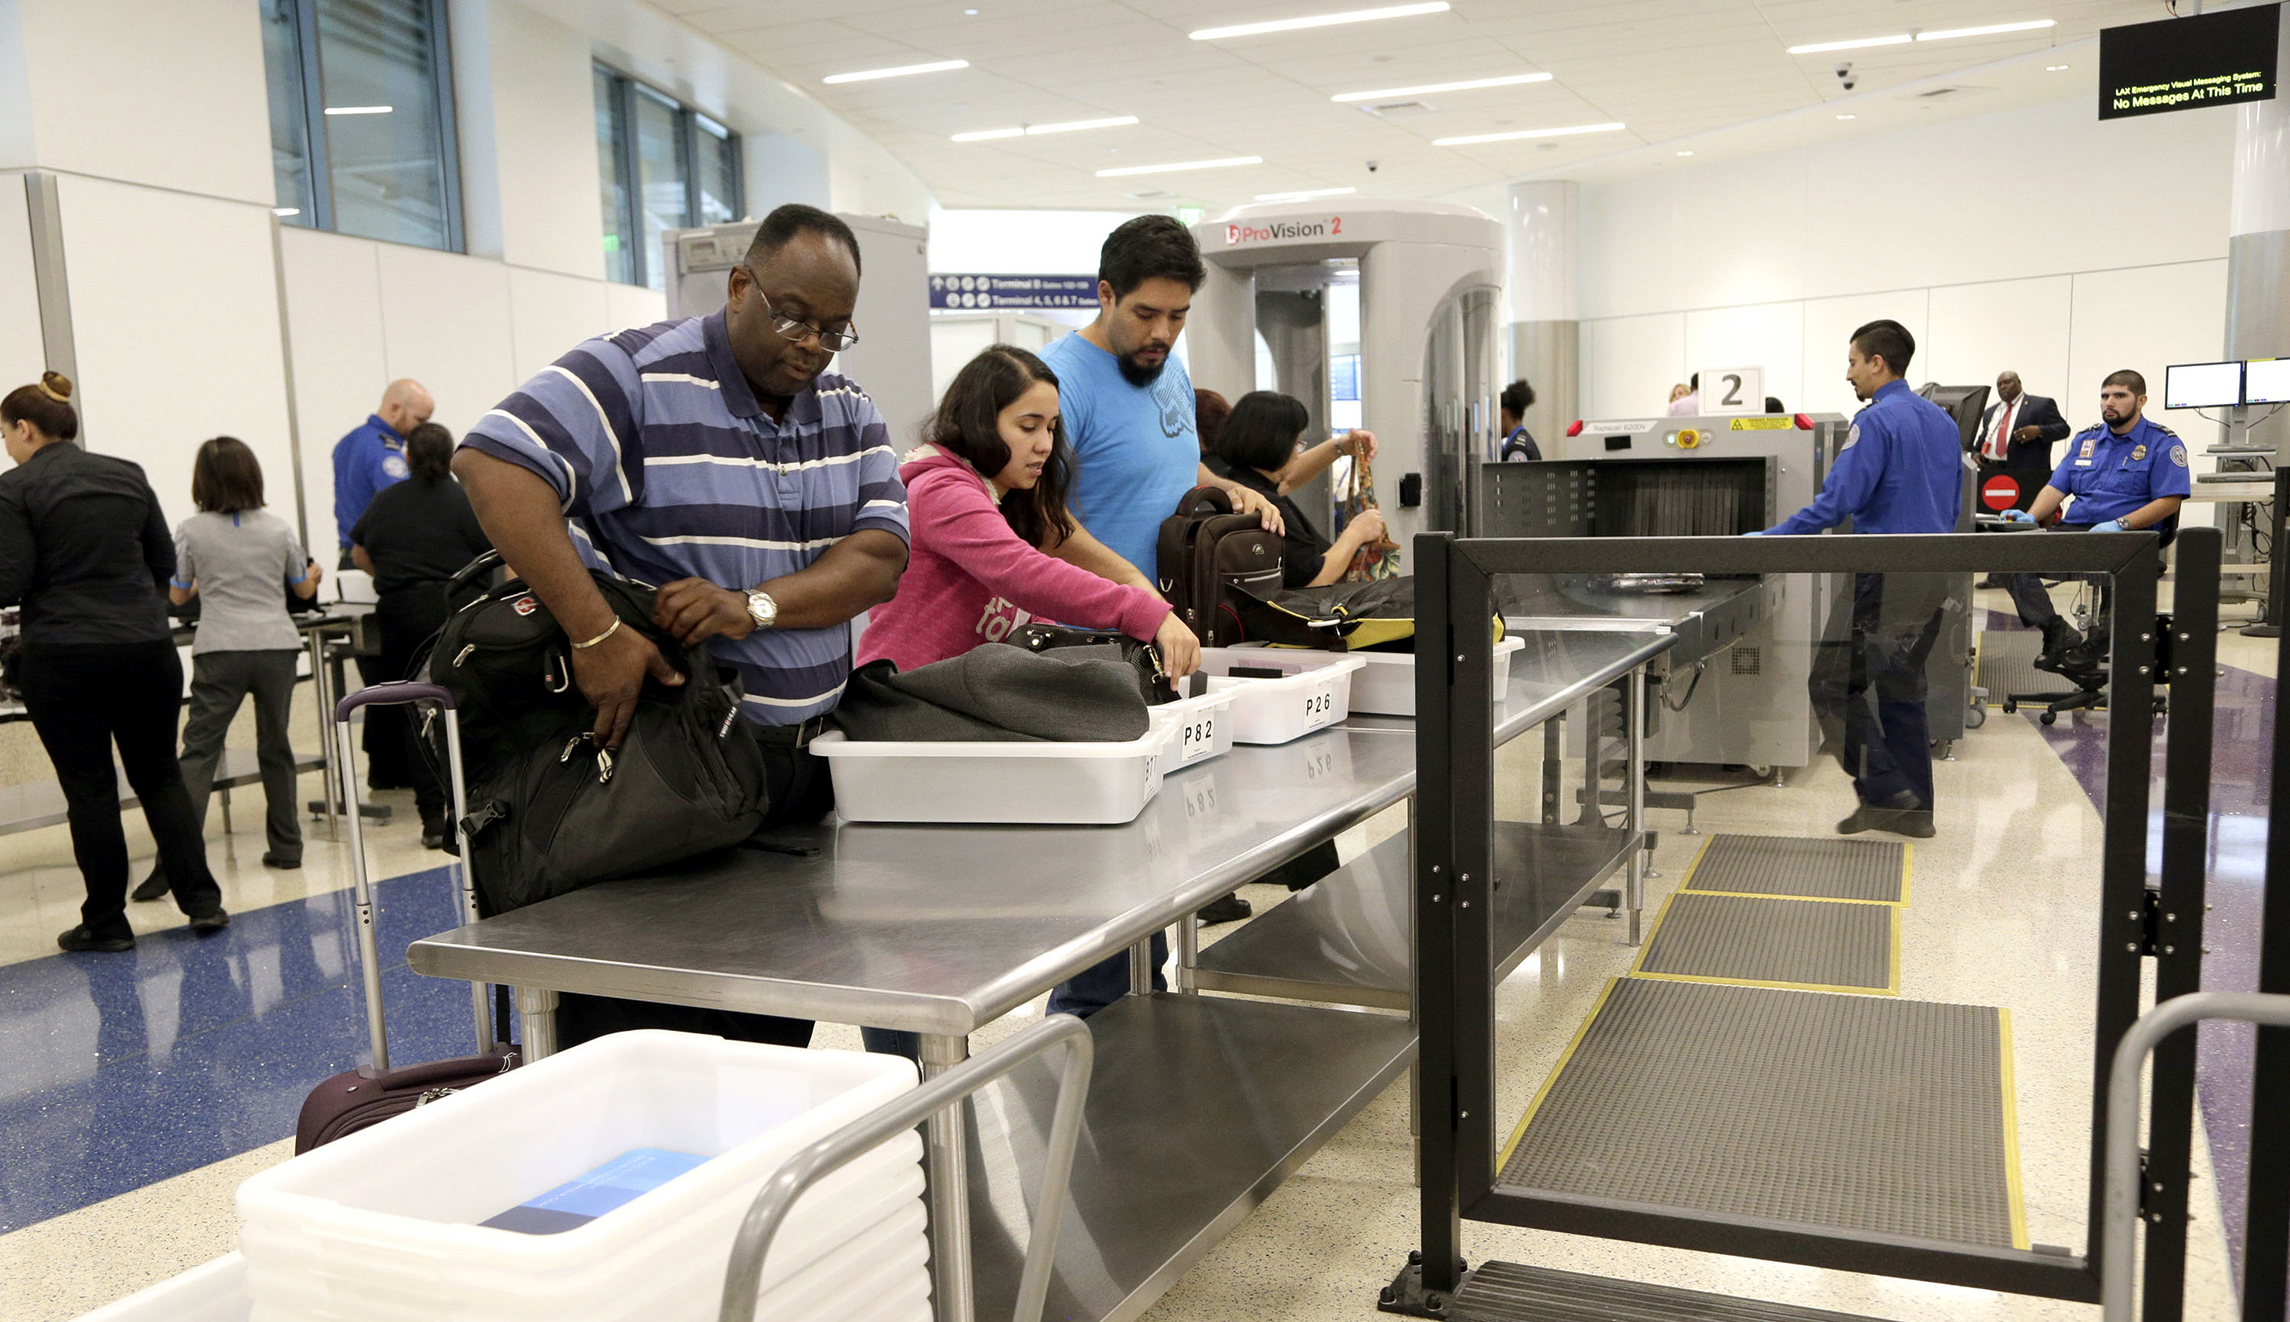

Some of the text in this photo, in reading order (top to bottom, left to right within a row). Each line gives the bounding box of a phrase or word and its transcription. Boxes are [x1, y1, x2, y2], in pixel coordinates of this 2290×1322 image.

[2113, 82, 2263, 110] No Messages At This Time
[2115, 71, 2262, 96] LAX Emergency Visual Messaging System:
[1243, 222, 1324, 242] ProVision
[1331, 216, 1342, 235] 2
[992, 279, 1032, 290] Terminal
[992, 295, 1033, 306] Terminal
[1070, 296, 1078, 306] 7
[1721, 373, 1744, 406] 2
[1306, 693, 1331, 717] P26
[1184, 720, 1213, 746] P82
